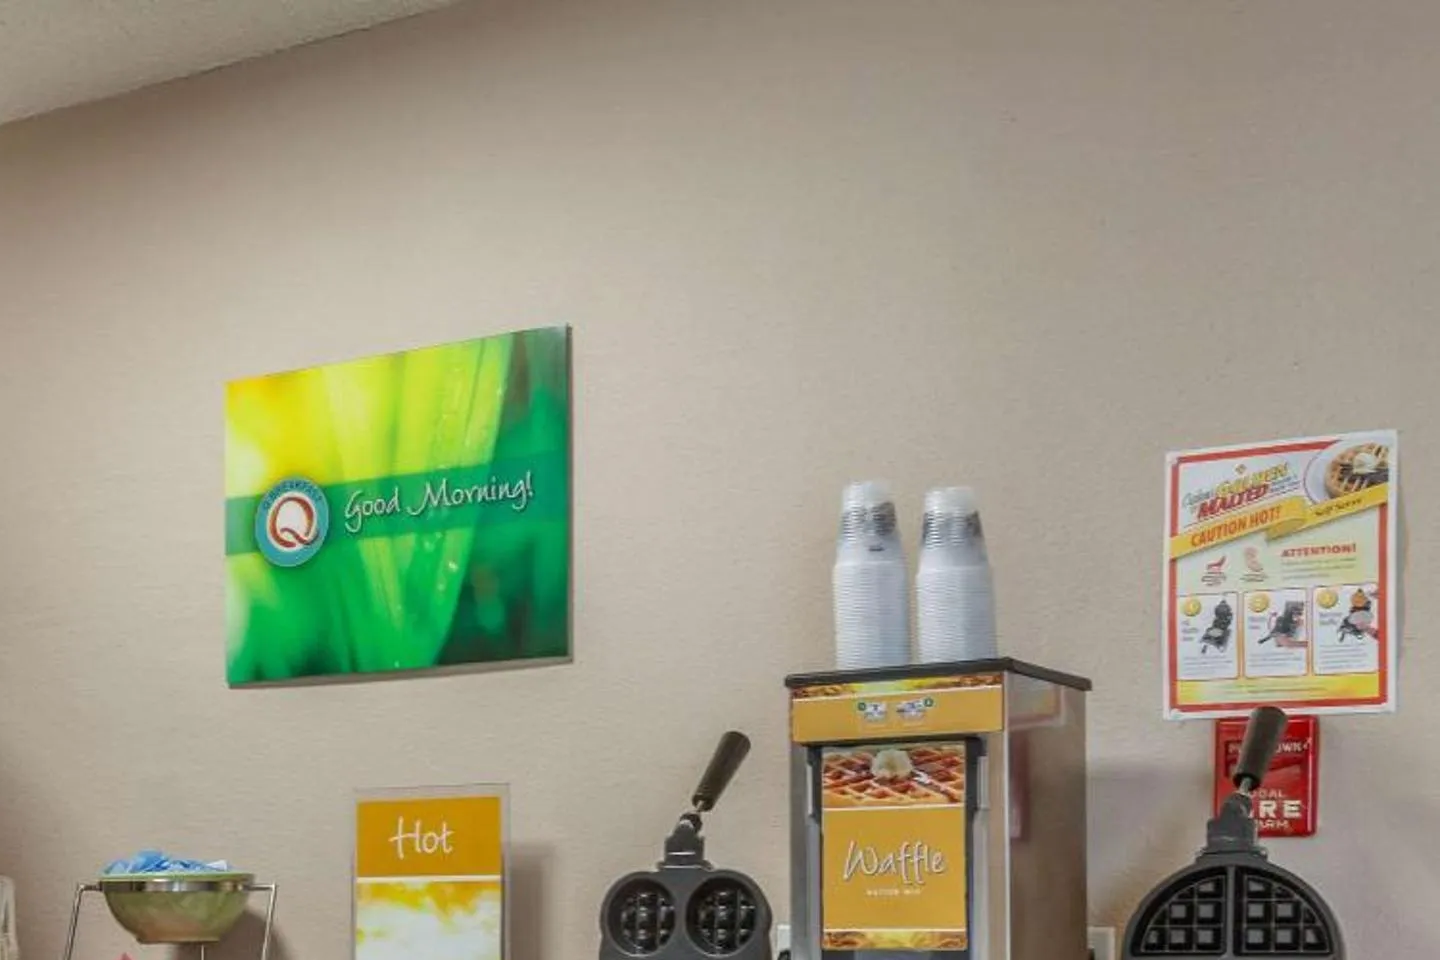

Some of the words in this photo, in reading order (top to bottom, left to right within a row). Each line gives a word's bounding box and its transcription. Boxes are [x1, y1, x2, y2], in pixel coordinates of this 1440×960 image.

[269, 496, 319, 549] Q
[344, 487, 400, 533] Good
[405, 471, 534, 516] Morning!
[1191, 517, 1247, 547] CAUTION
[1249, 504, 1281, 528] HOT!
[1281, 543, 1357, 558] ATTENTION!
[1249, 800, 1302, 819] RE
[388, 816, 456, 860] Hot
[843, 839, 948, 886] Waffle
